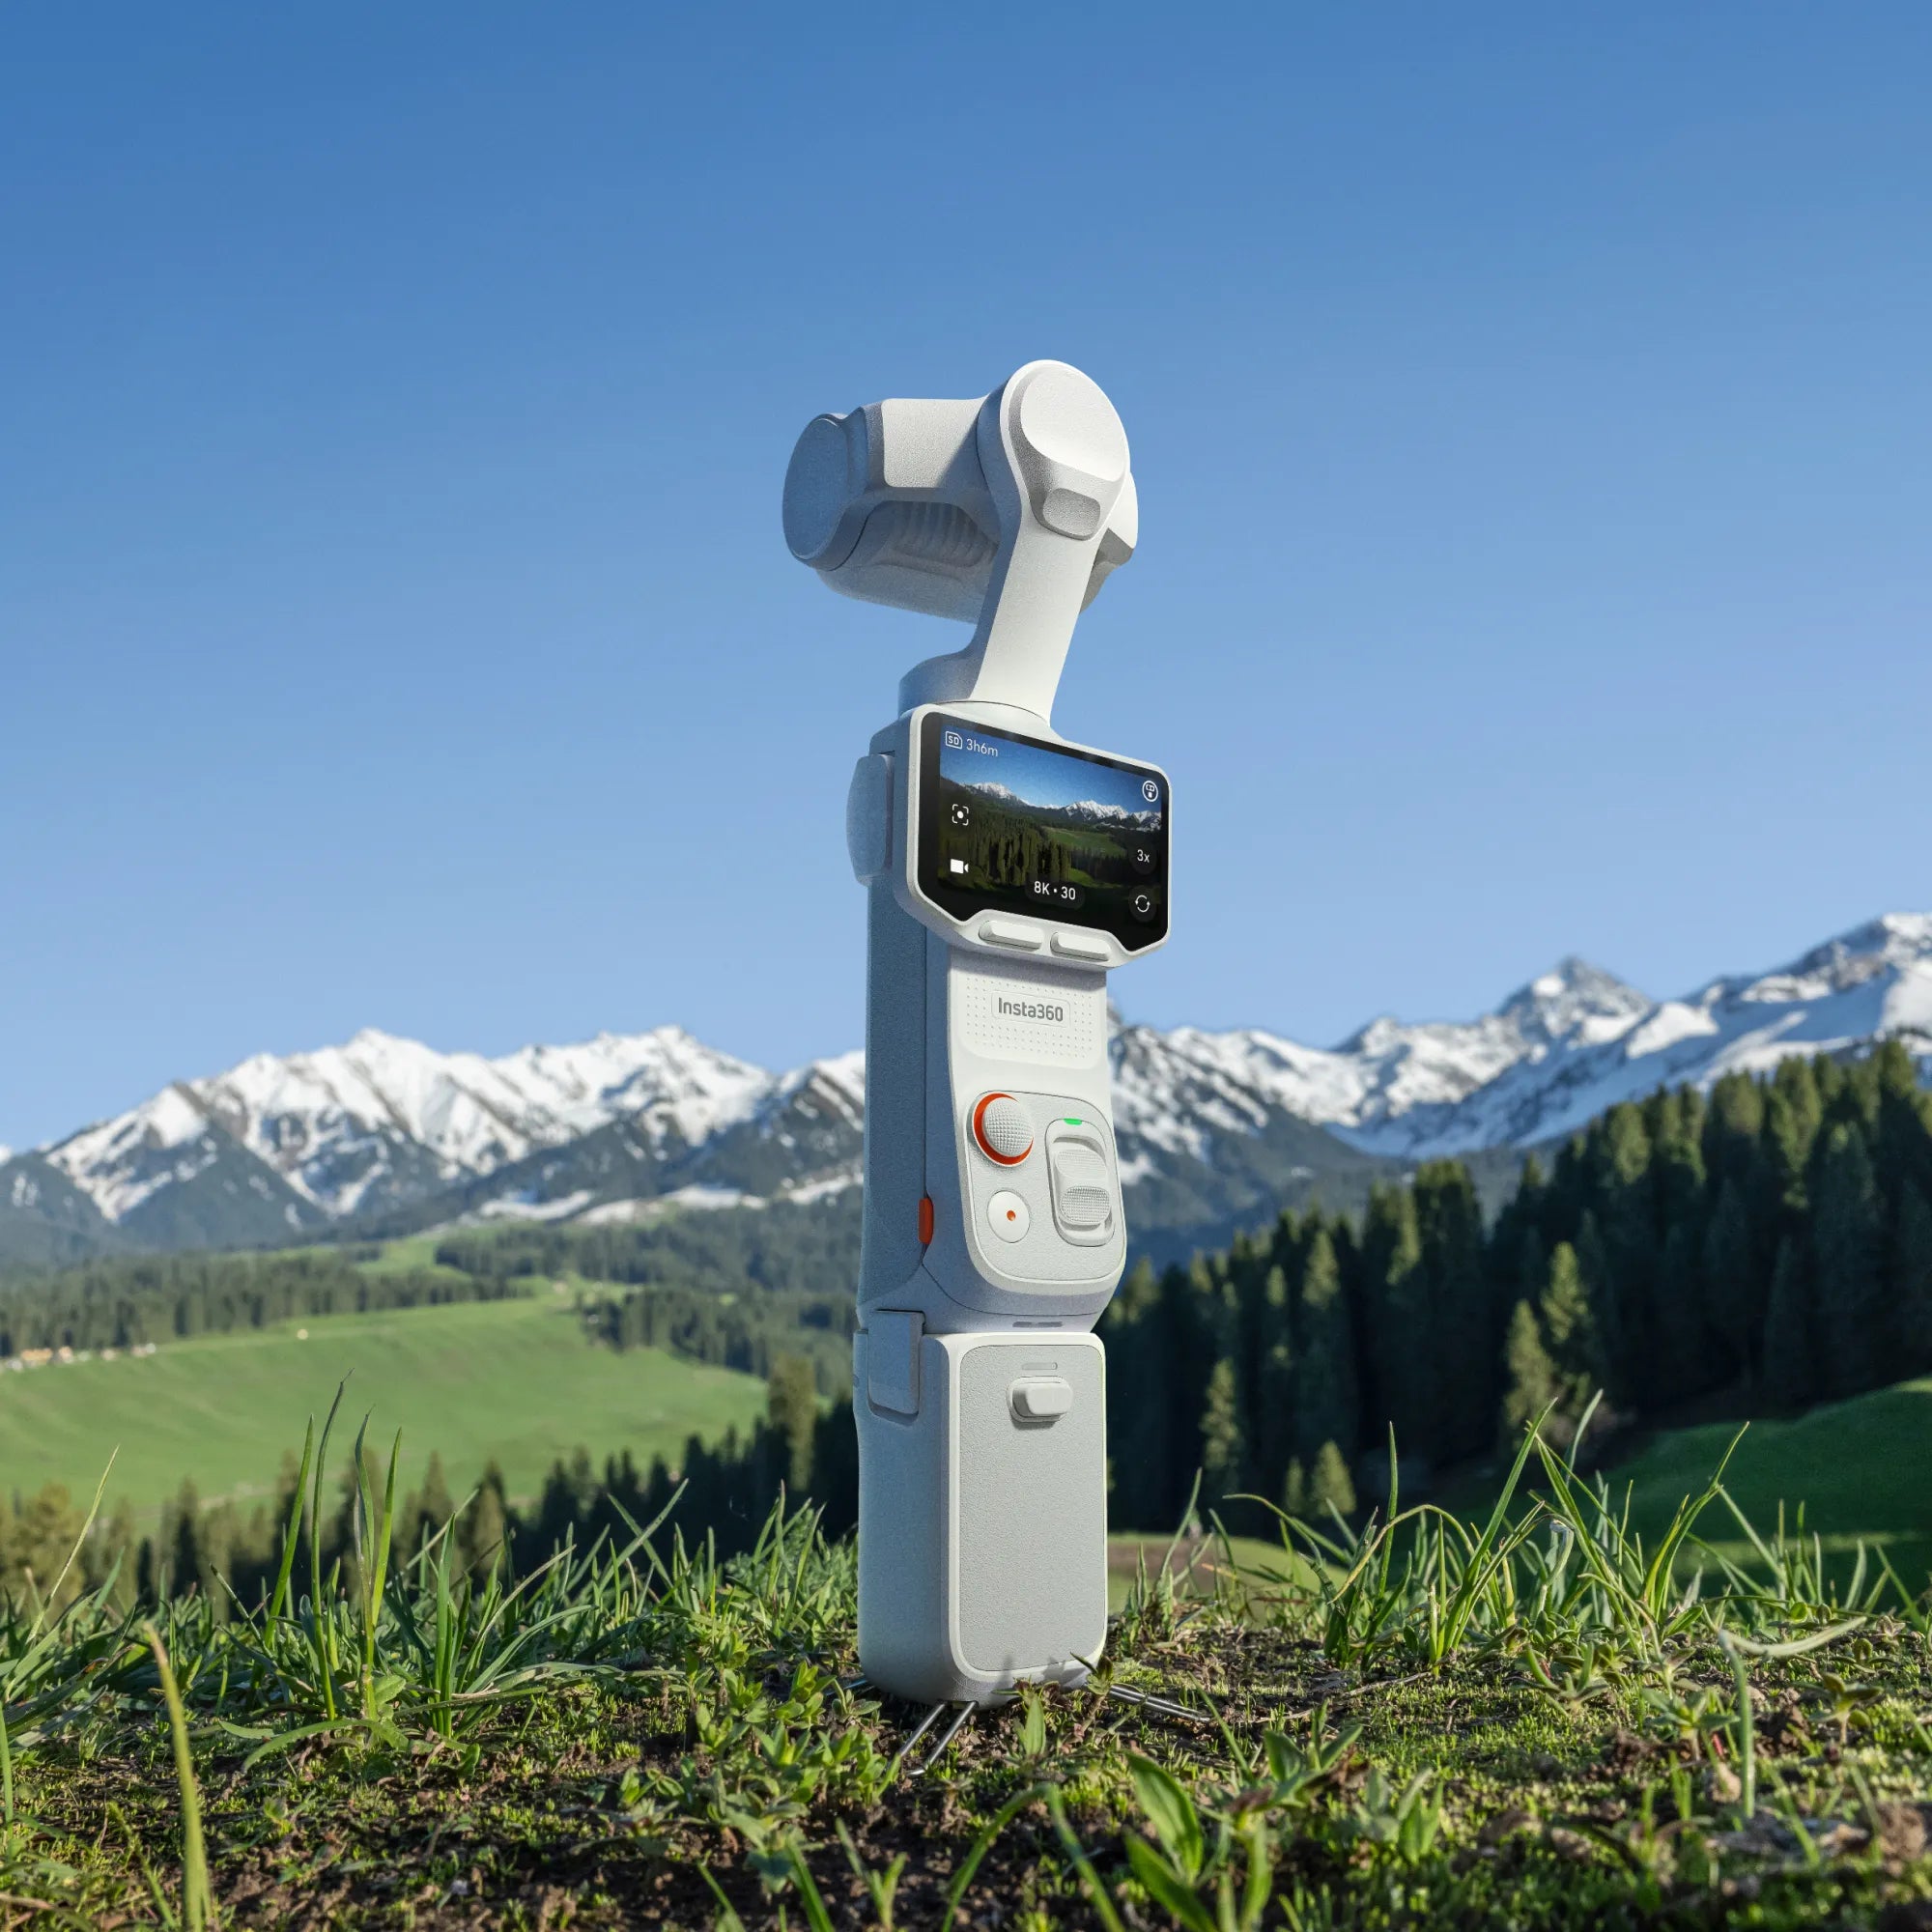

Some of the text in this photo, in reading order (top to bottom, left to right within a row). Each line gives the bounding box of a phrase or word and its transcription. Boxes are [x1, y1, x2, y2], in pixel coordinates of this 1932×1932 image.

[948, 735, 999, 757] SD 3h6m
[1136, 848, 1151, 864] 3x
[1034, 880, 1076, 900] 8K 30
[998, 996, 1064, 1022] Insta360
